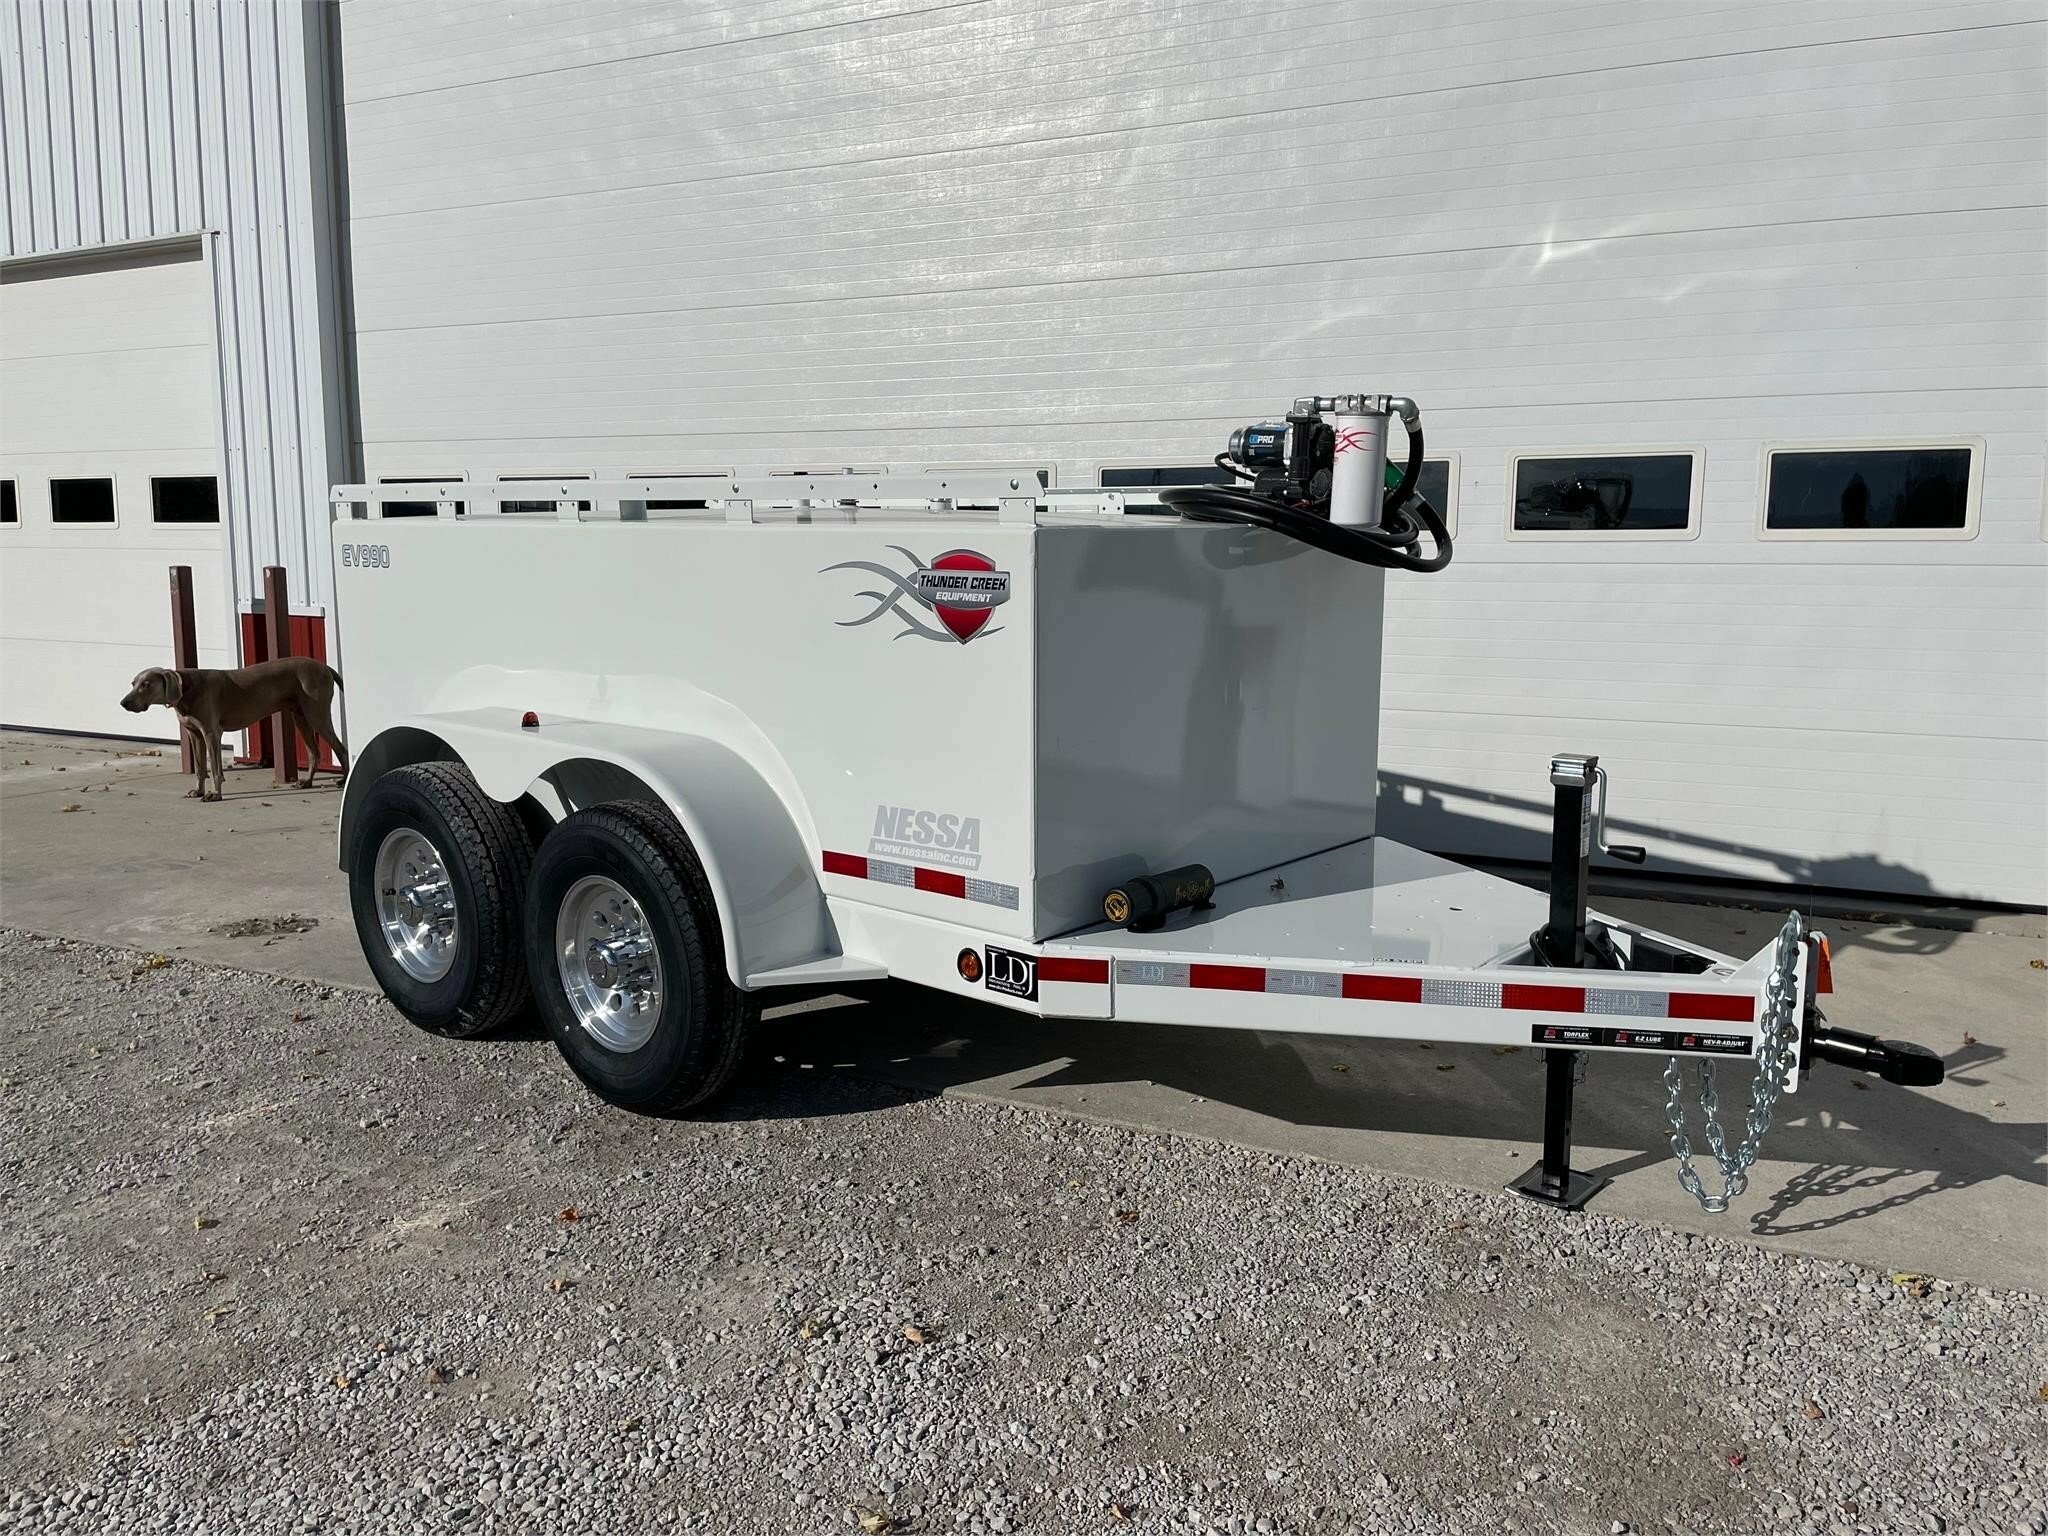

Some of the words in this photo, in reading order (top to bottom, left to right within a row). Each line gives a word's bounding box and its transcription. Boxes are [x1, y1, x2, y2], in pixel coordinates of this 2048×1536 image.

[341, 544, 391, 569] EV990
[920, 574, 968, 589] THUNDER
[970, 576, 1008, 591] CREEK
[935, 591, 993, 603] EQUIPMENT
[872, 805, 982, 853] NESSA
[874, 842, 977, 867] www.nessainc.com
[988, 951, 1037, 996] LDJ
